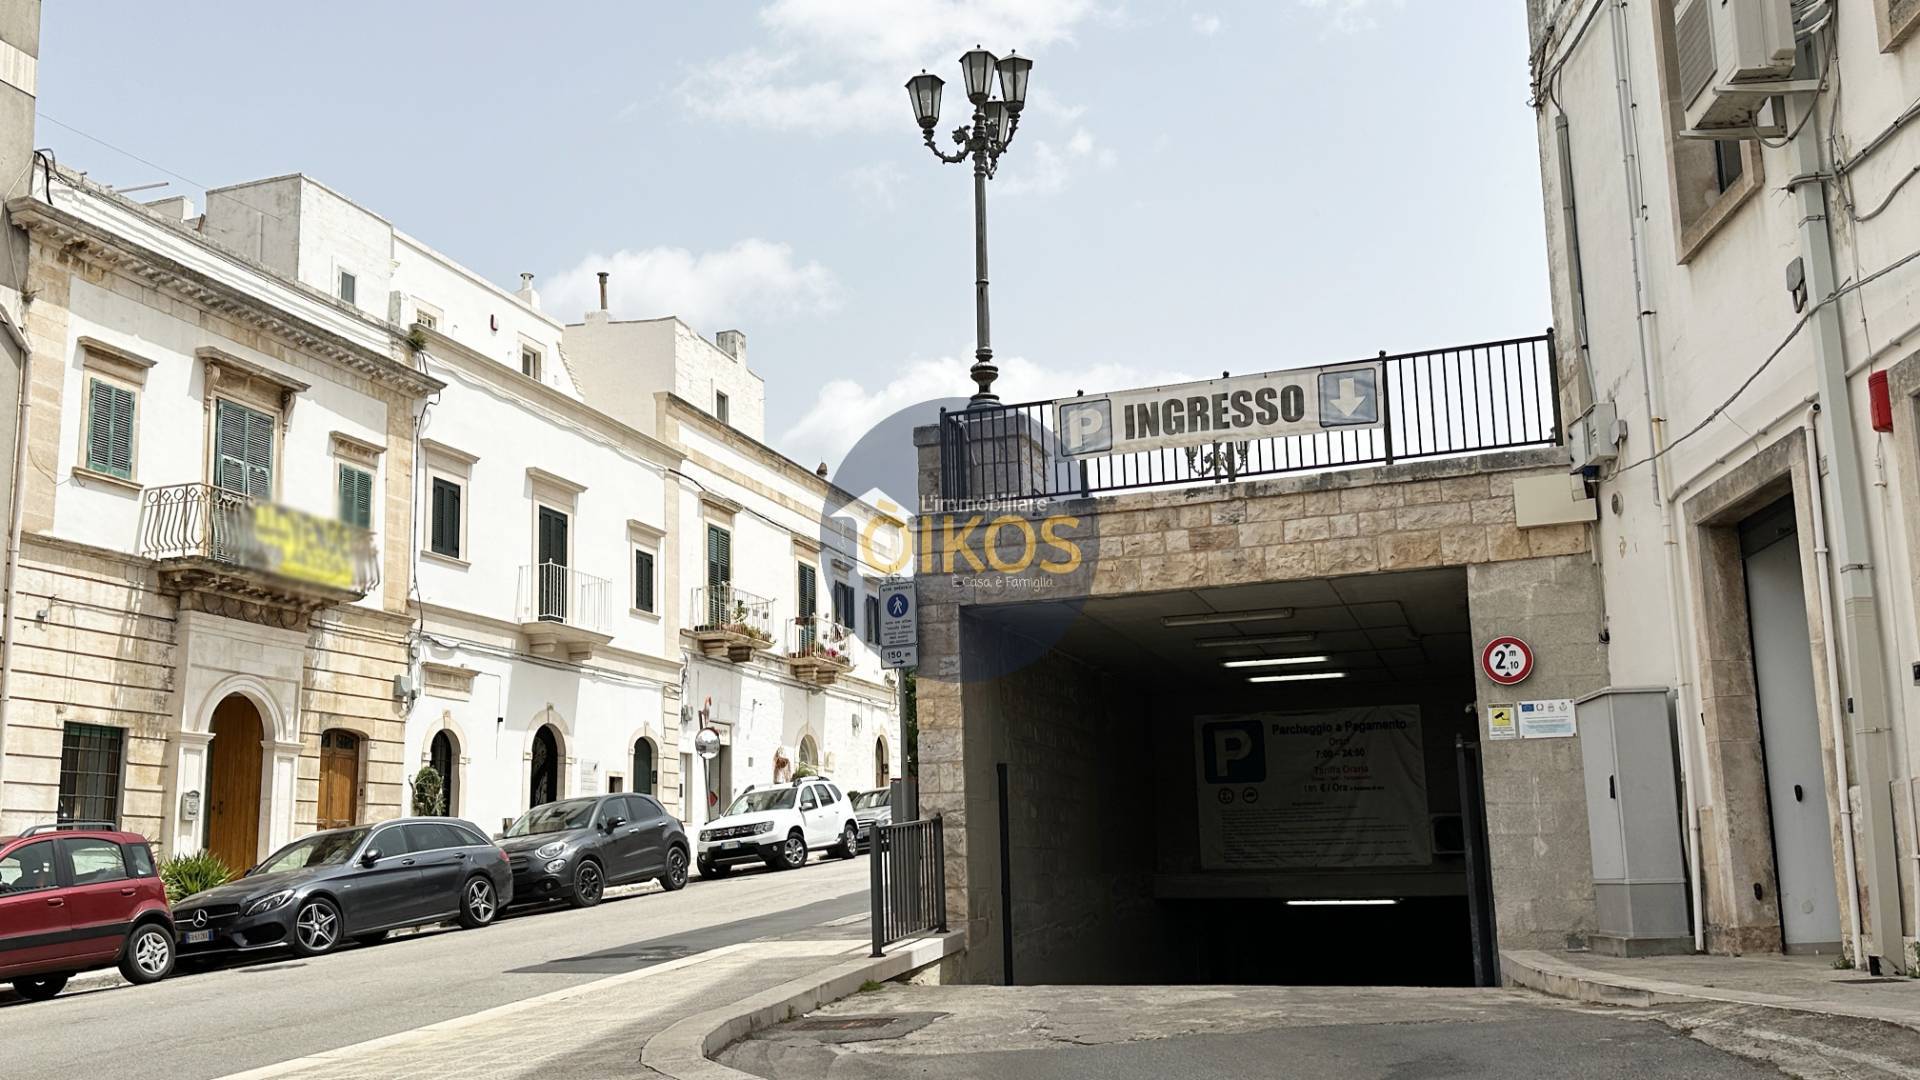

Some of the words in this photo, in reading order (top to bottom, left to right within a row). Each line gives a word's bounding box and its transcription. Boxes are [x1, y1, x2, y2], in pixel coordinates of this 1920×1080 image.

[1069, 407, 1103, 449] P
[1124, 384, 1305, 441] INGRESSO
[887, 650, 902, 659] 150
[1271, 724, 1333, 736] Parcheggio
[1335, 724, 1342, 732] a
[1344, 719, 1407, 733] Pagamento
[1214, 729, 1253, 777] P
